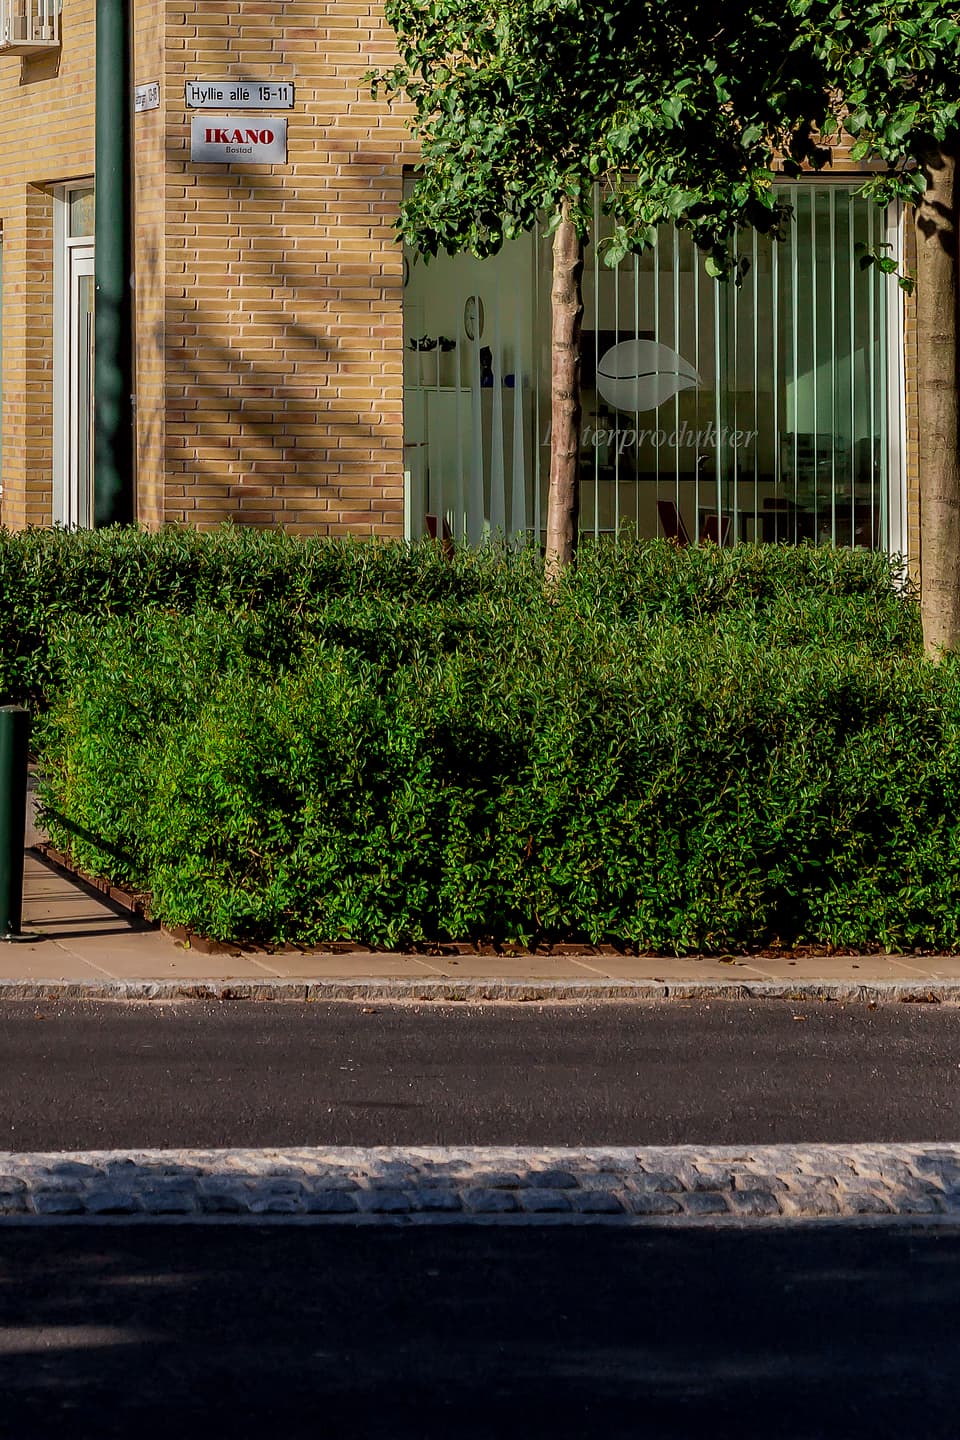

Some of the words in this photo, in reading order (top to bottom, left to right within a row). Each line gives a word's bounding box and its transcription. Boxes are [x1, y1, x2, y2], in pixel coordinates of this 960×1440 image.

[191, 87, 224, 103] Hyllie
[229, 87, 250, 101] allé
[258, 87, 288, 101] 15-11
[205, 128, 275, 145] IKANO
[225, 145, 253, 154] Bostad
